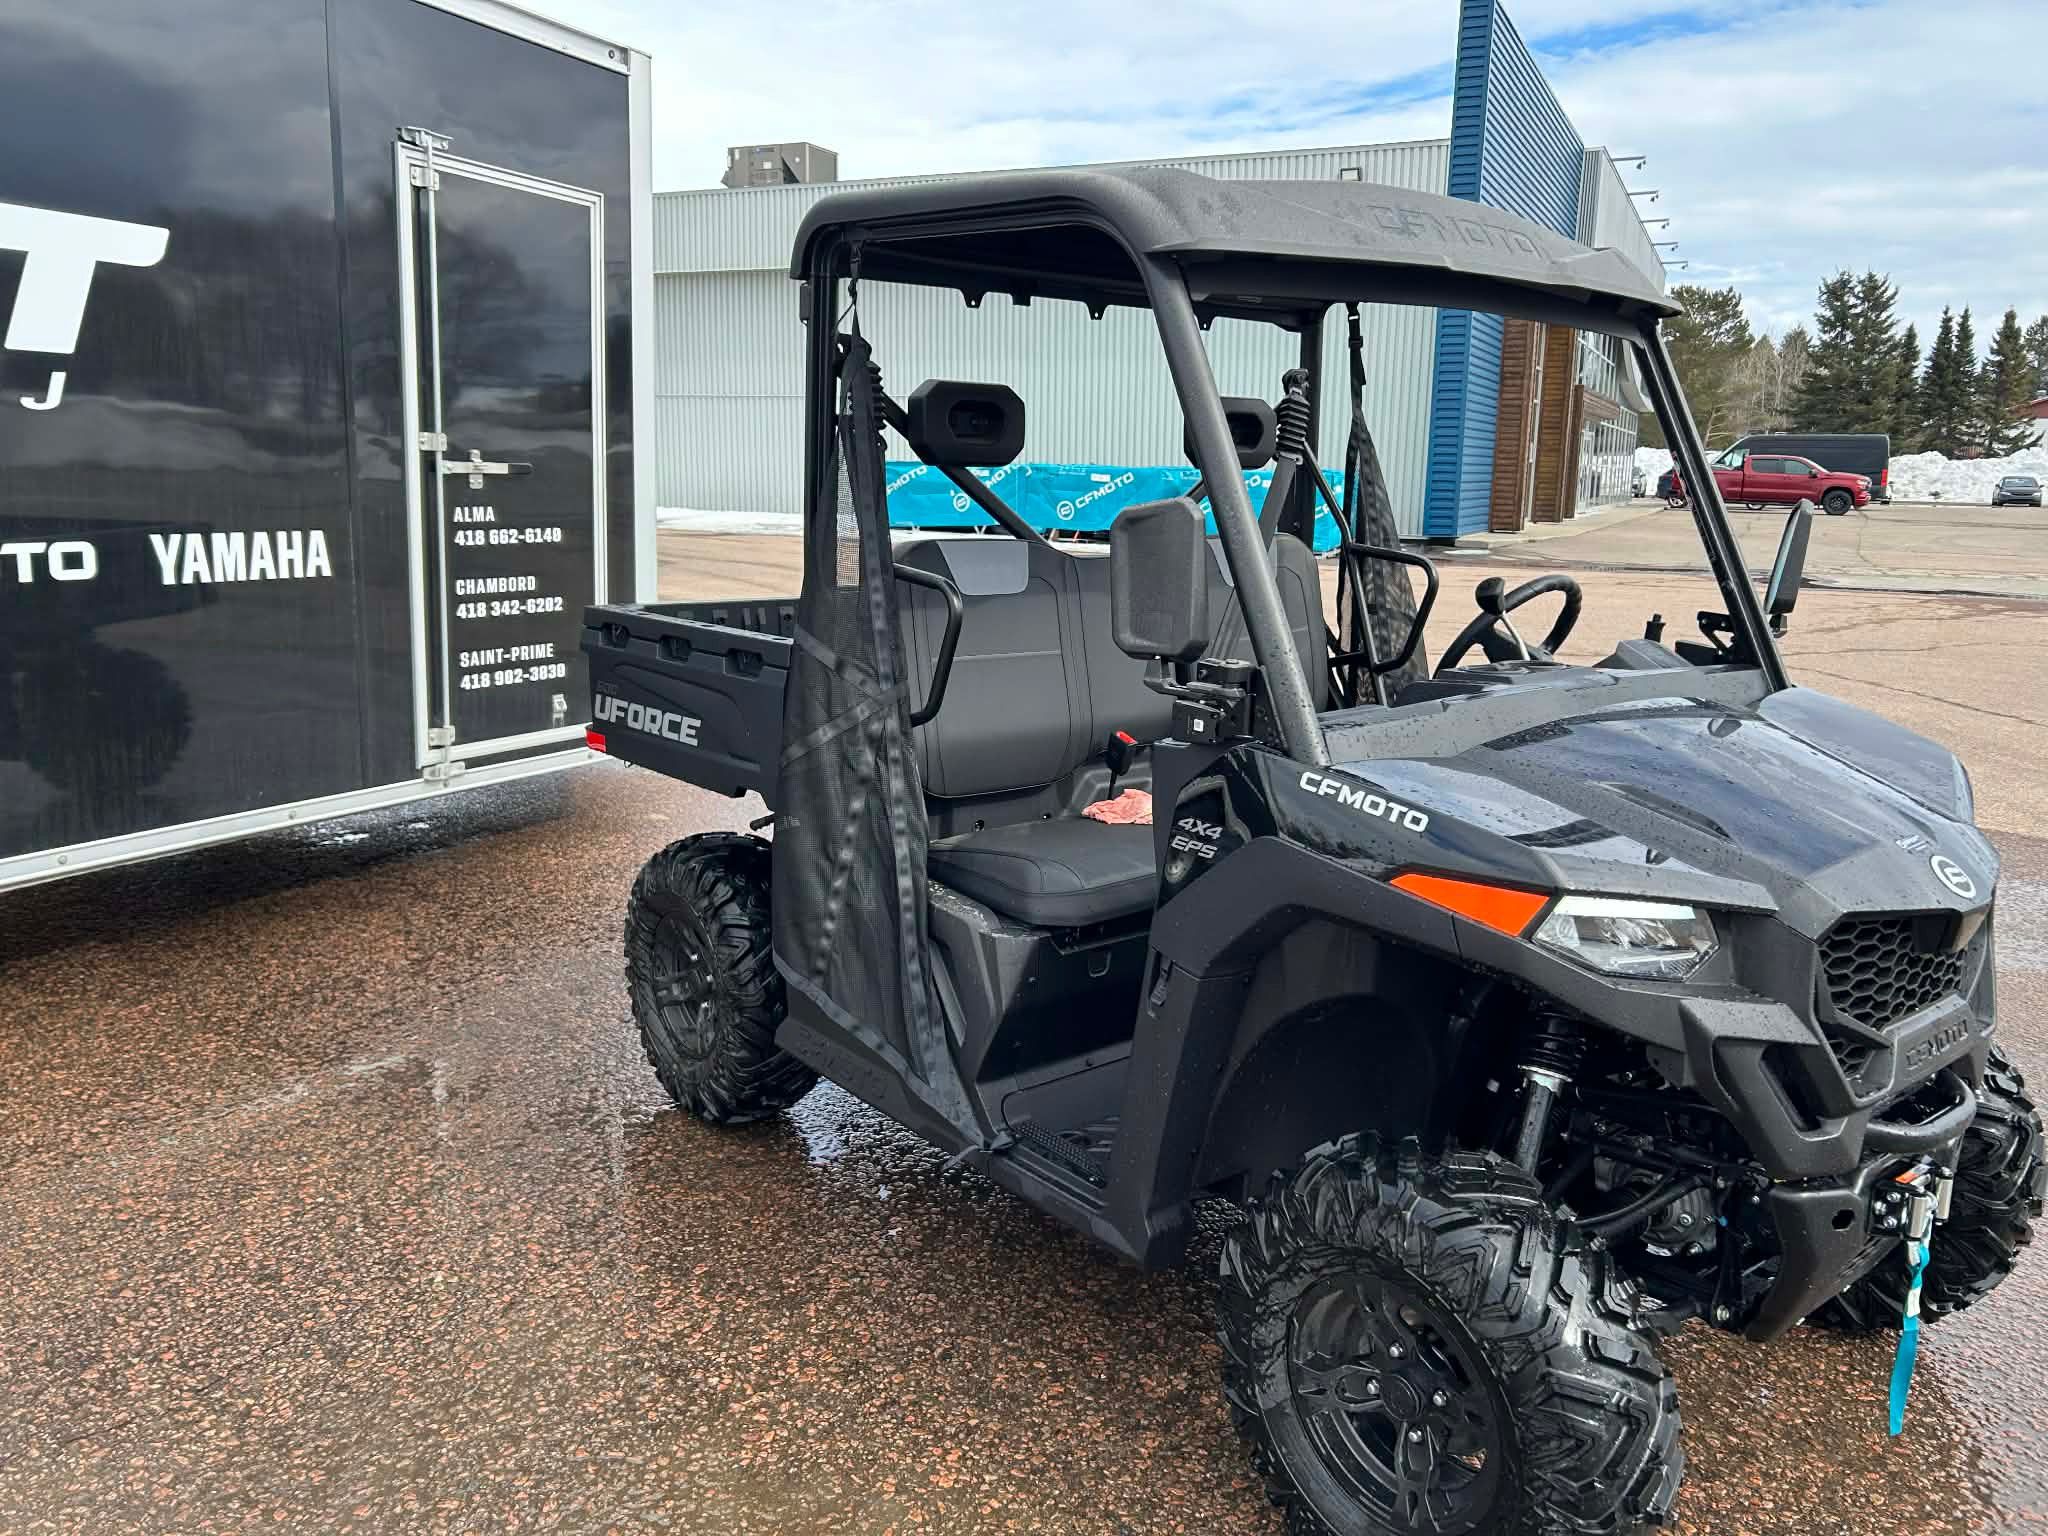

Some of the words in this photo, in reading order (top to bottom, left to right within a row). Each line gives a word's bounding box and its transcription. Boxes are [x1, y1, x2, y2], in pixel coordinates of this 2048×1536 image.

[886, 464, 928, 496] FMOTO
[1075, 472, 1135, 509] CFMOTO
[453, 506, 496, 523] ALMA
[454, 529, 486, 546] 418
[489, 527, 562, 545] 662-6140
[149, 530, 334, 586] YAMAHA
[456, 575, 536, 596] CHAMBORD
[456, 602, 487, 619] 418
[490, 596, 564, 617] 342-6202
[460, 642, 554, 668] SAINT-PRIME
[460, 672, 491, 691] 418
[494, 662, 566, 686] 902-3830
[594, 693, 702, 747] UFORCE
[1299, 771, 1430, 833] CFMOTO
[1177, 817, 1223, 840] 4X4
[1171, 835, 1218, 859] EPS
